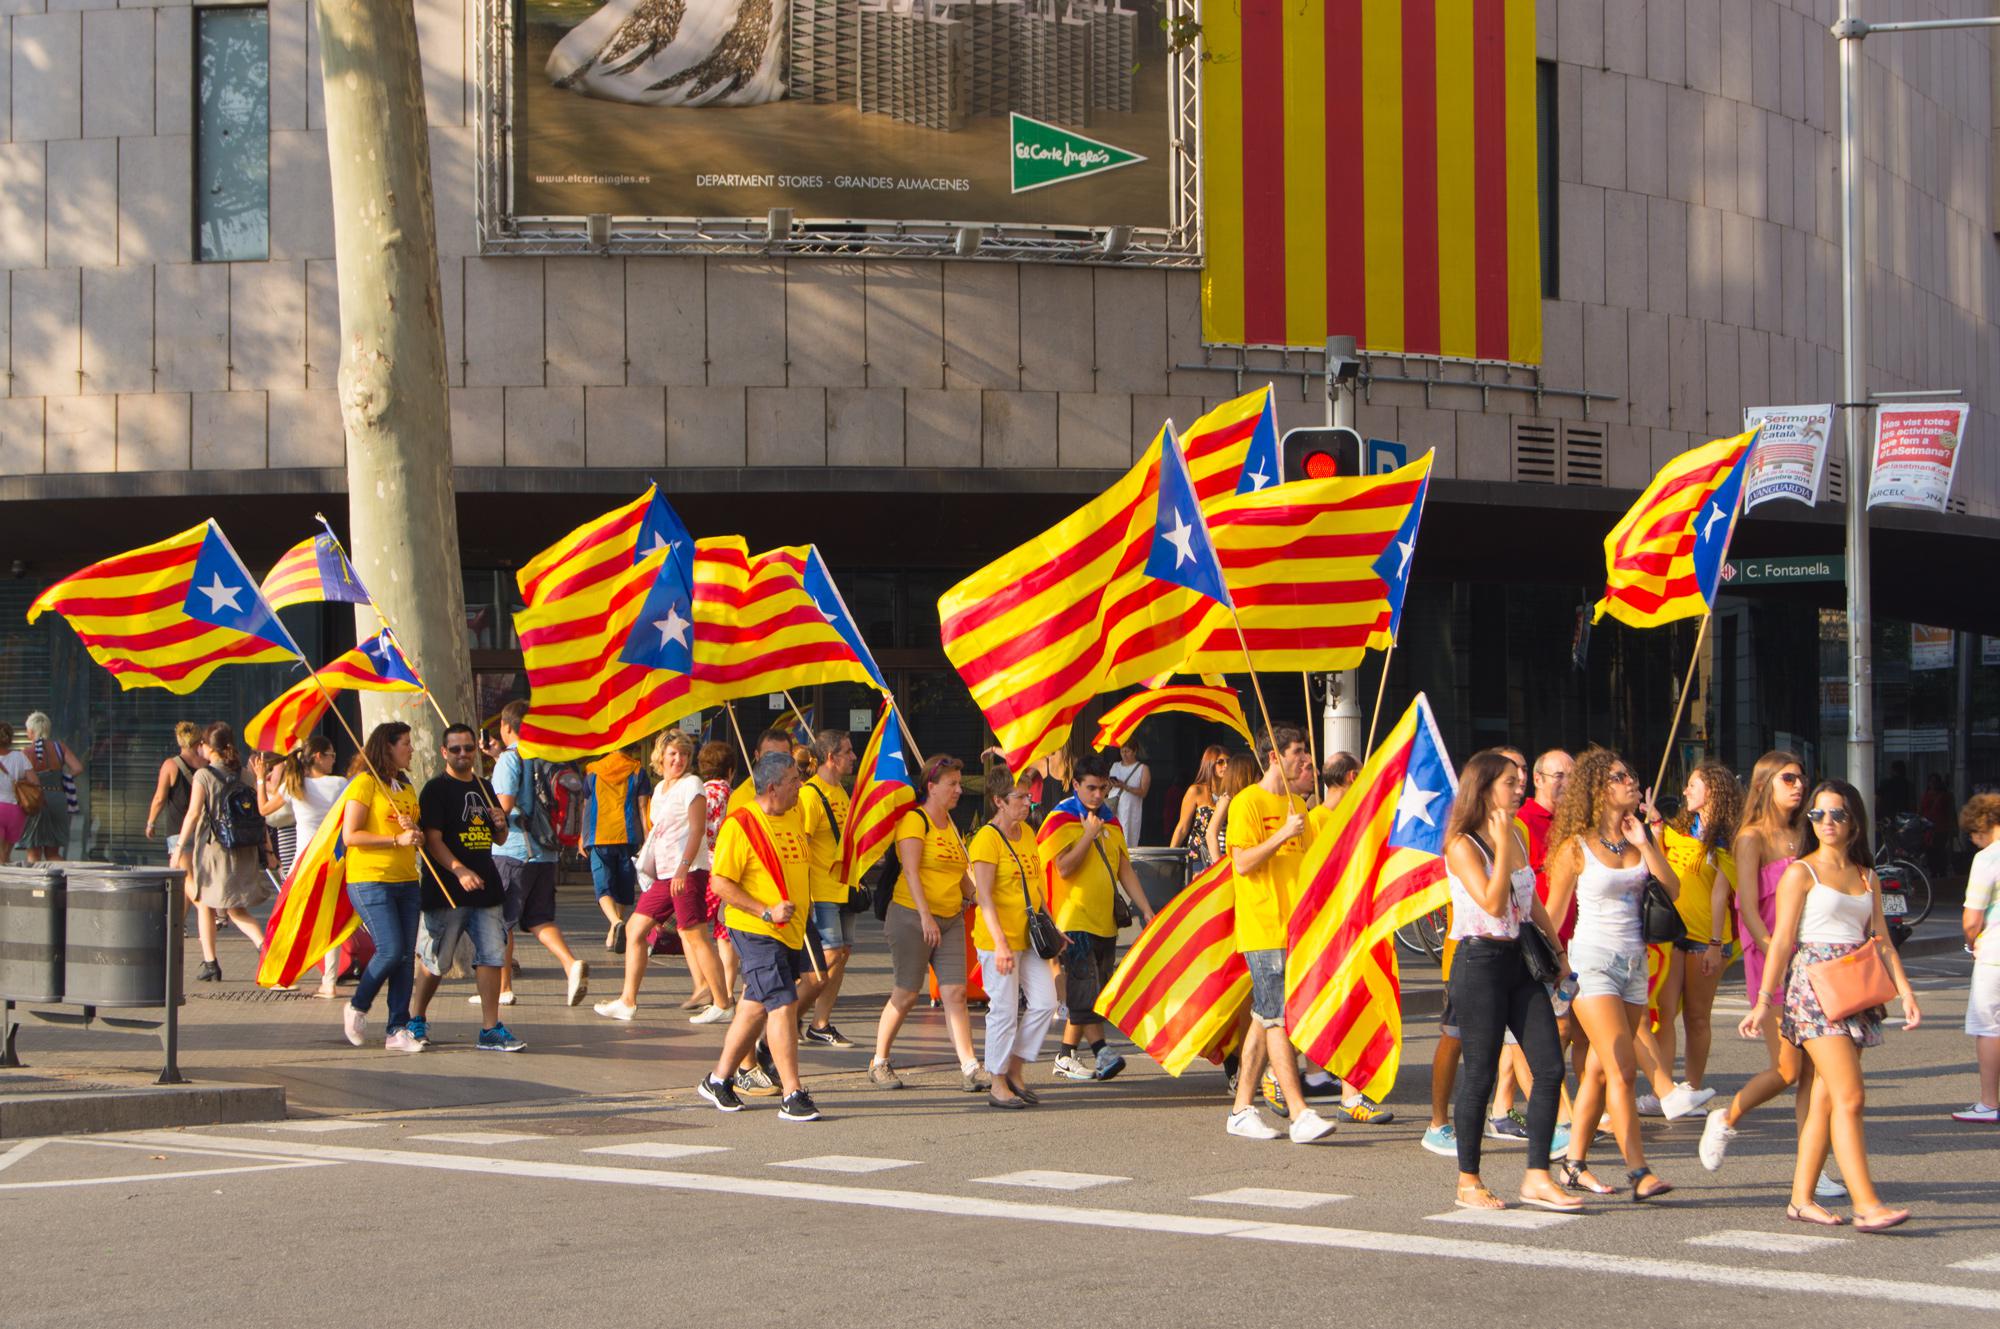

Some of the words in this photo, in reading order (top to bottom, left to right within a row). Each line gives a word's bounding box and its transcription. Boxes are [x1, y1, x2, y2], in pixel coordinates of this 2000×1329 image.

[1015, 142, 1030, 159] El
[1030, 144, 1063, 160] Corte
[535, 174, 650, 186] www.elcorteingles.es
[696, 174, 775, 187] DEPARTMENT
[778, 175, 823, 188] STORES
[834, 176, 894, 189] GRANDES
[896, 177, 970, 191] ALMACENES
[1764, 415, 1825, 424] Setmana
[1924, 418, 1951, 427] totes
[1764, 424, 1794, 432] Llibre
[1746, 564, 1761, 578] C.
[1765, 562, 1830, 577] Fontanella
